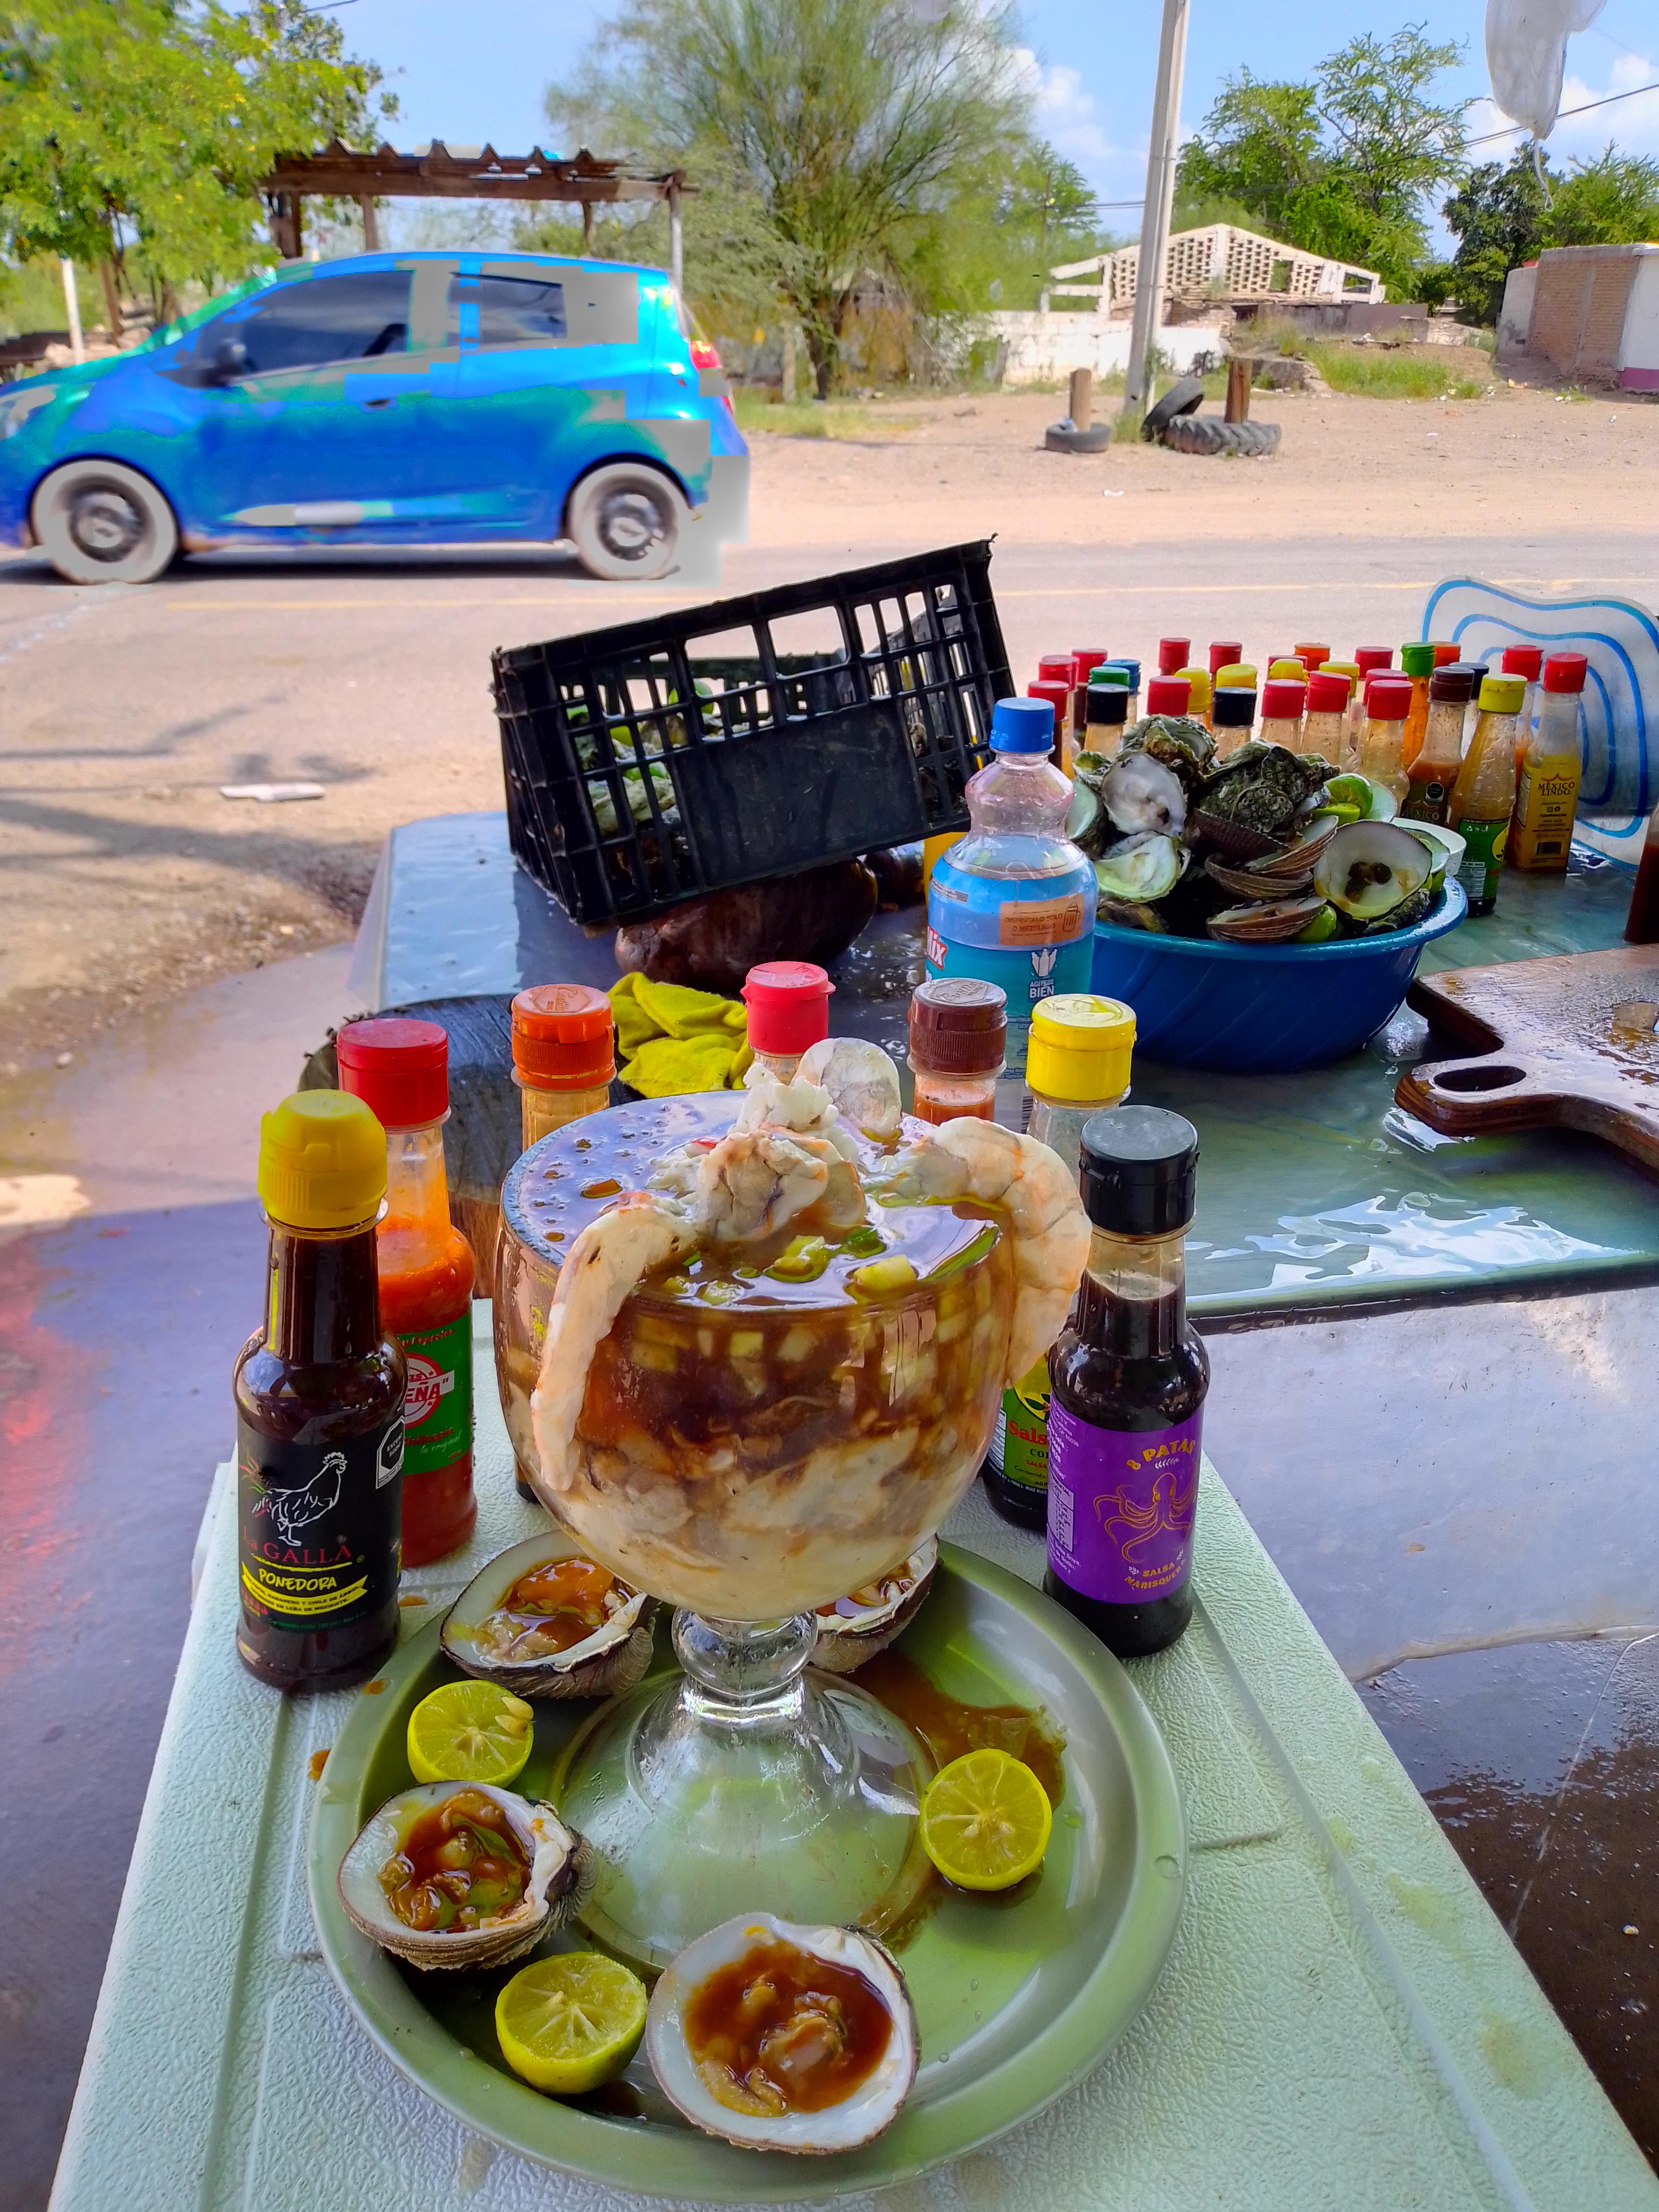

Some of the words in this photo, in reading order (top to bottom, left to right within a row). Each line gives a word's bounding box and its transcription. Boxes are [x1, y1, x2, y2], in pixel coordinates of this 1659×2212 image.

[1005, 915, 1045, 924] DISFRÚTALO
[1029, 985, 1054, 999] BIEN
[1008, 1420, 1048, 1446] Sals
[1142, 1438, 1196, 1462] PATAS
[263, 1543, 352, 1564] GALLA
[258, 1568, 337, 1591] PONEDORA
[1142, 1562, 1175, 1577] SALSA
